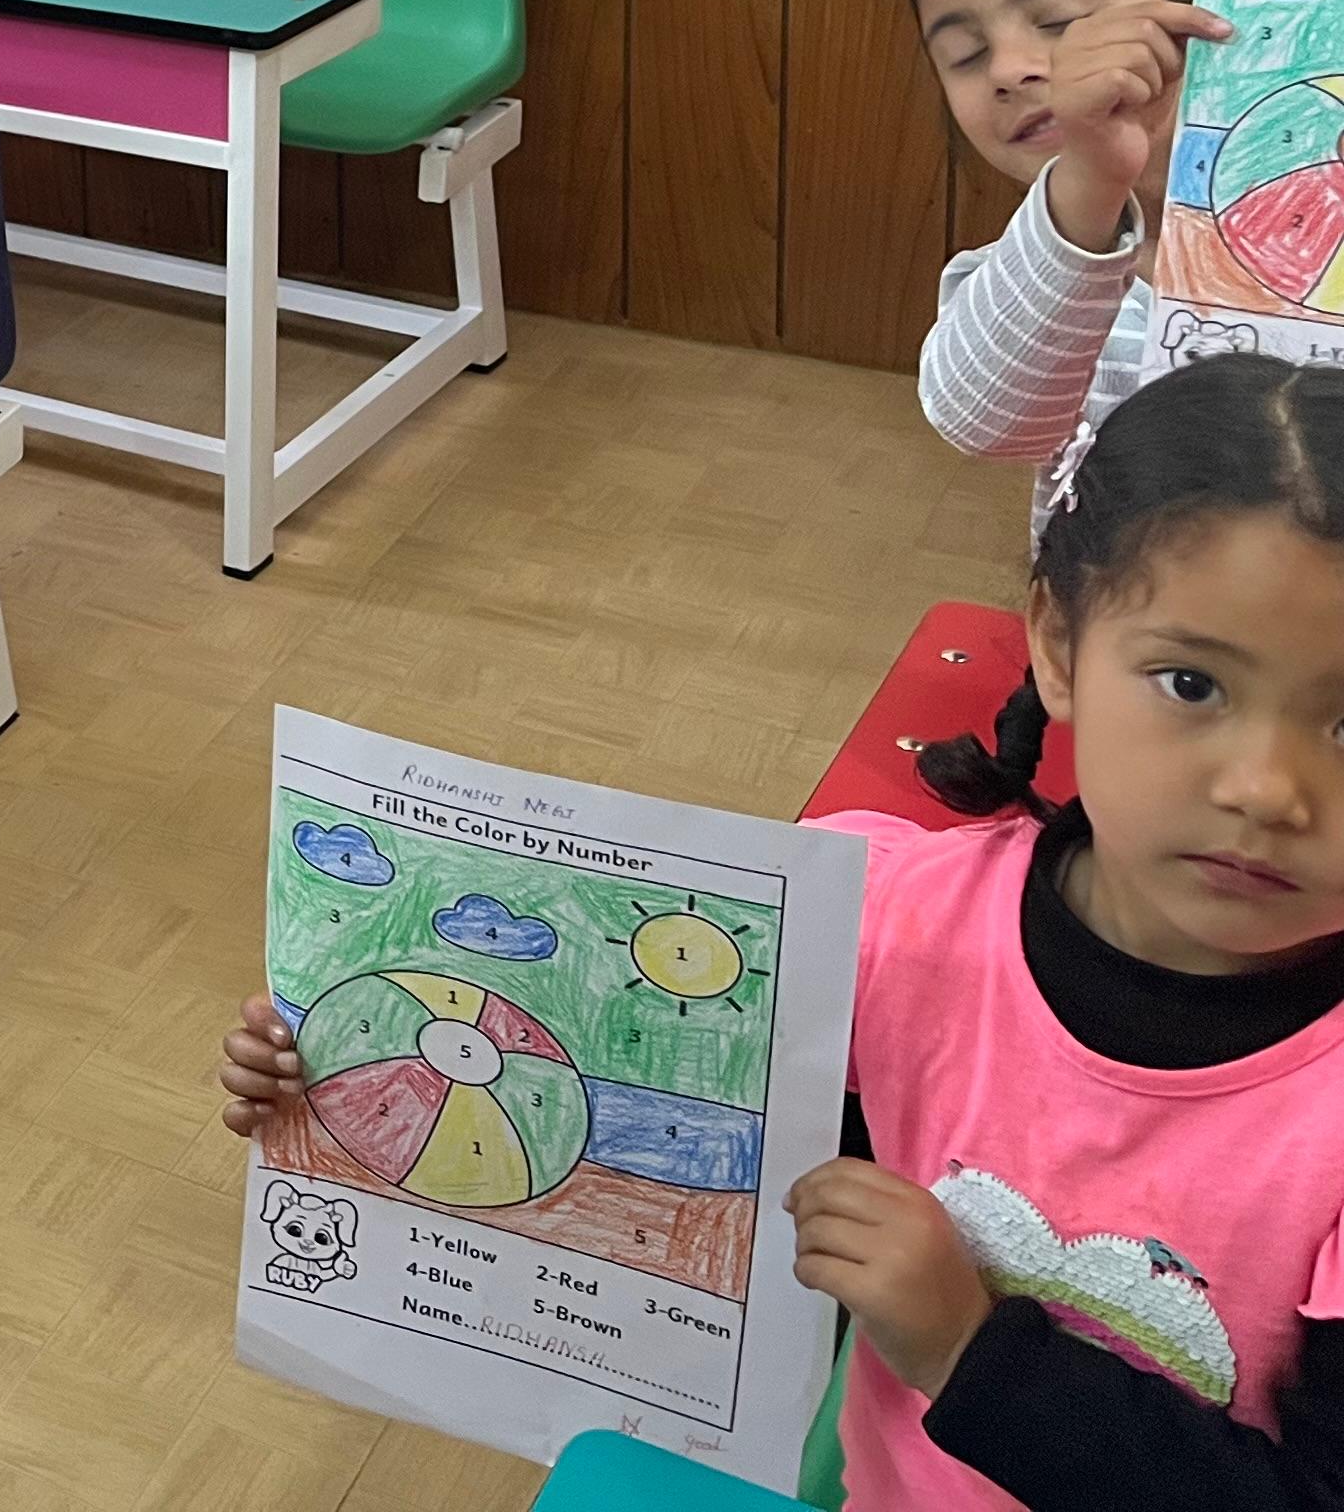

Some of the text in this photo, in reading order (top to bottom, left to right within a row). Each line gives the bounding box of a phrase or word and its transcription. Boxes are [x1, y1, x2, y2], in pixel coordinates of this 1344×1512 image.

[1261, 27, 1272, 40] 3
[1282, 130, 1293, 143] 3
[1195, 161, 1206, 174] 4
[1293, 213, 1304, 228] 2
[372, 794, 654, 872] Fill the Color by Number
[340, 852, 352, 867] 4
[329, 909, 341, 923] 3
[485, 927, 688, 962] 4 1
[447, 991, 459, 1005] 1
[359, 1021, 641, 1043] 3 2 3
[460, 1045, 472, 1059] 5
[378, 1093, 543, 1118] 2 3
[472, 1125, 678, 1155] 1 4
[634, 1230, 647, 1244] 5
[266, 1263, 321, 1294] RUBY
[410, 1227, 732, 1339] 1-Yellow 2-Red 3-Green
[406, 1262, 622, 1339] 4-Blue 5-Brown
